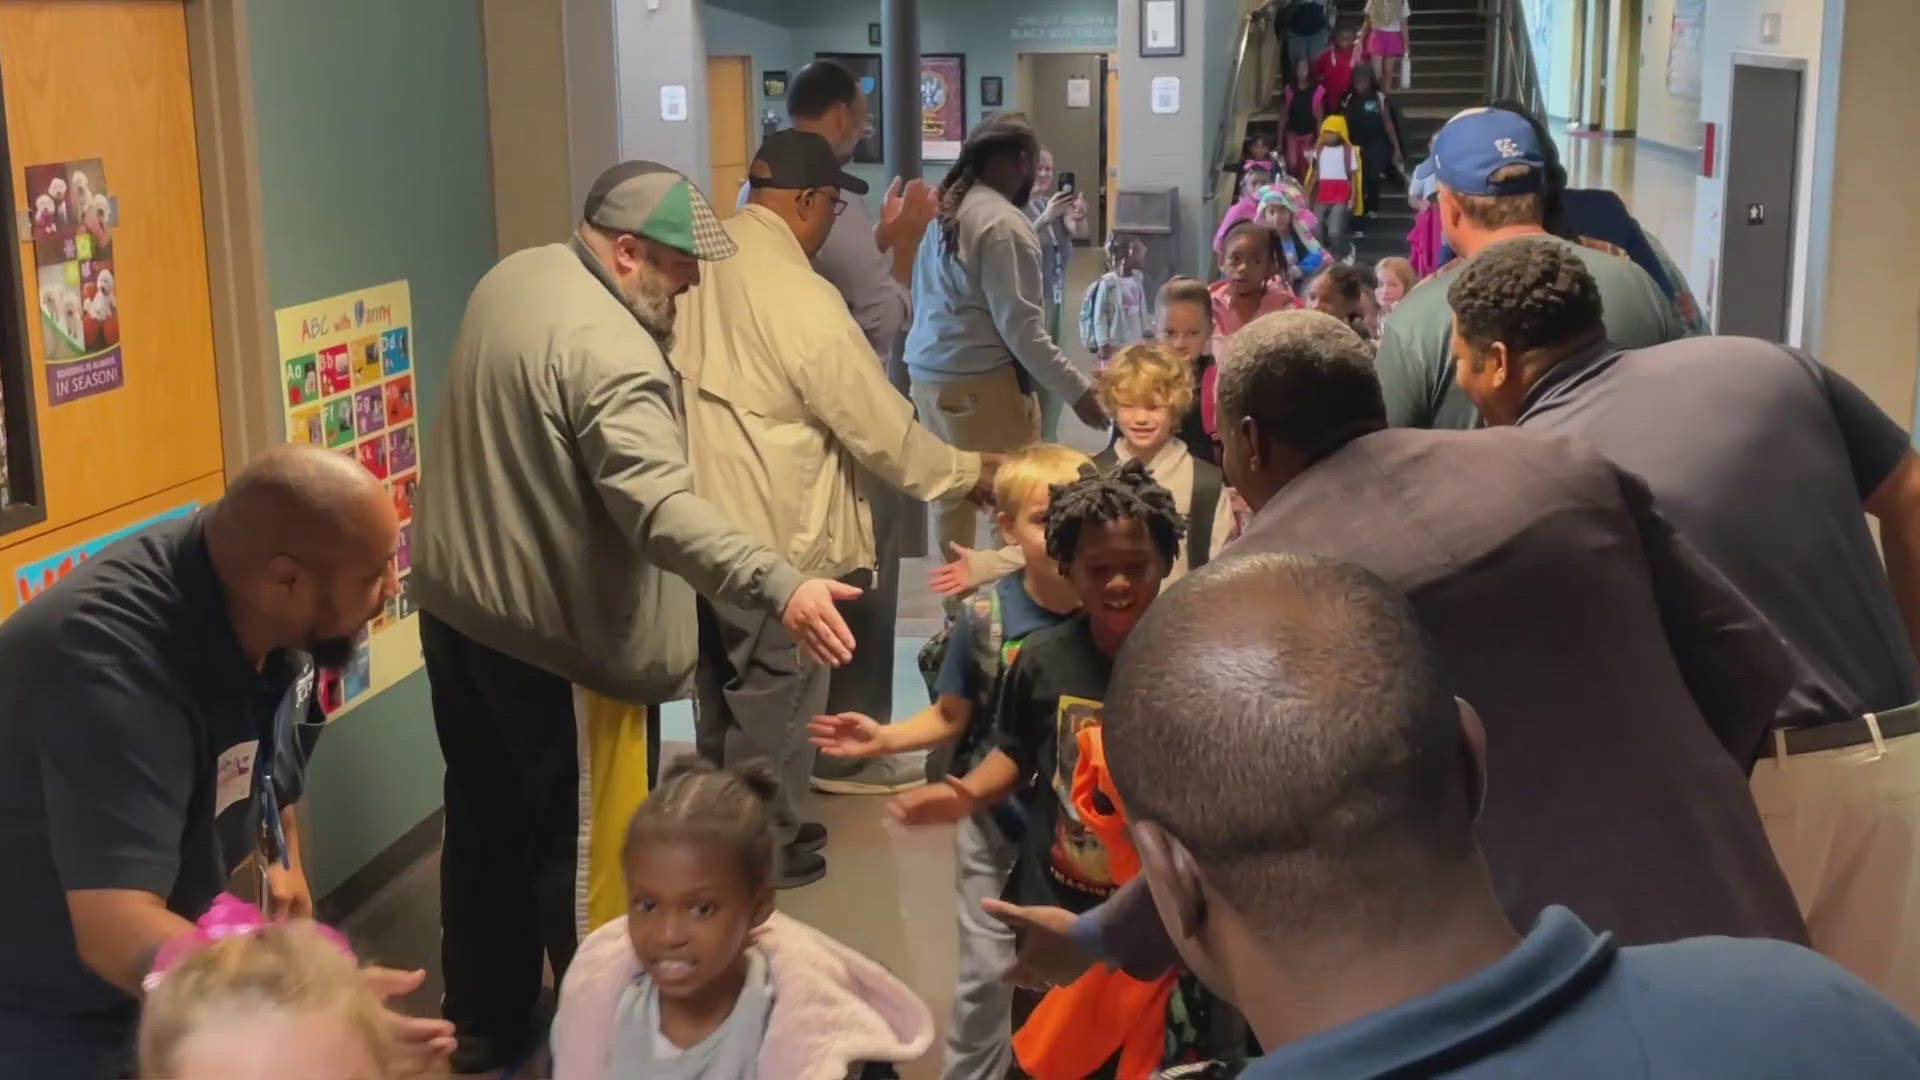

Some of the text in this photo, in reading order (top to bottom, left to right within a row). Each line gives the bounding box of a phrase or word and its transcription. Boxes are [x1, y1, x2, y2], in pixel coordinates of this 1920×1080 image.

[301, 314, 329, 343] ABC
[56, 367, 119, 397] IN SEASON!
